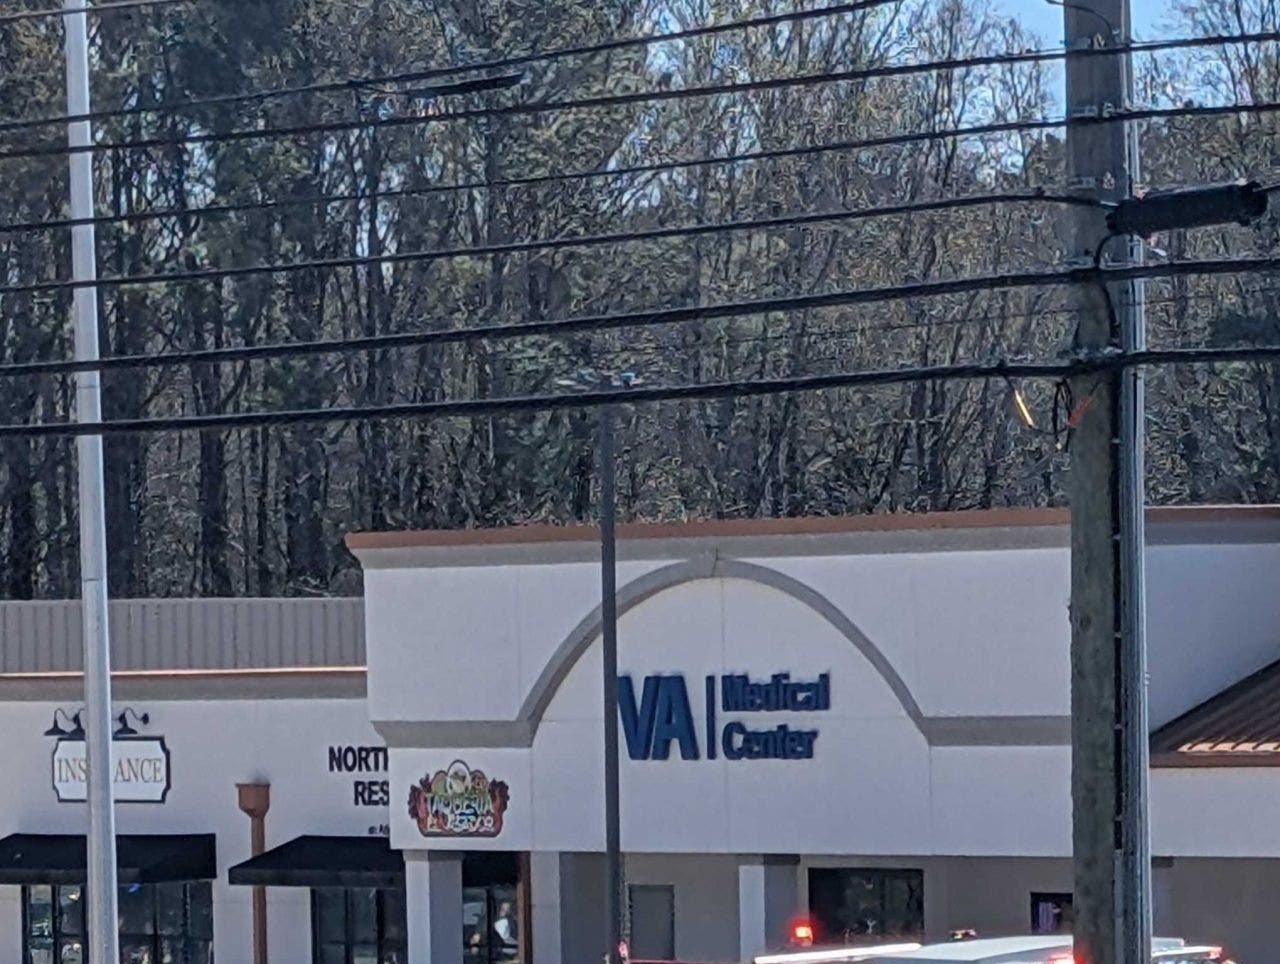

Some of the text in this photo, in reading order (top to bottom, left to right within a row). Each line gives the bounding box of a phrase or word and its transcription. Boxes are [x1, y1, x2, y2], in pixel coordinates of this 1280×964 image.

[616, 672, 831, 760] VA Medical
[722, 721, 819, 760] Center
[58, 757, 163, 783] INSANCE
